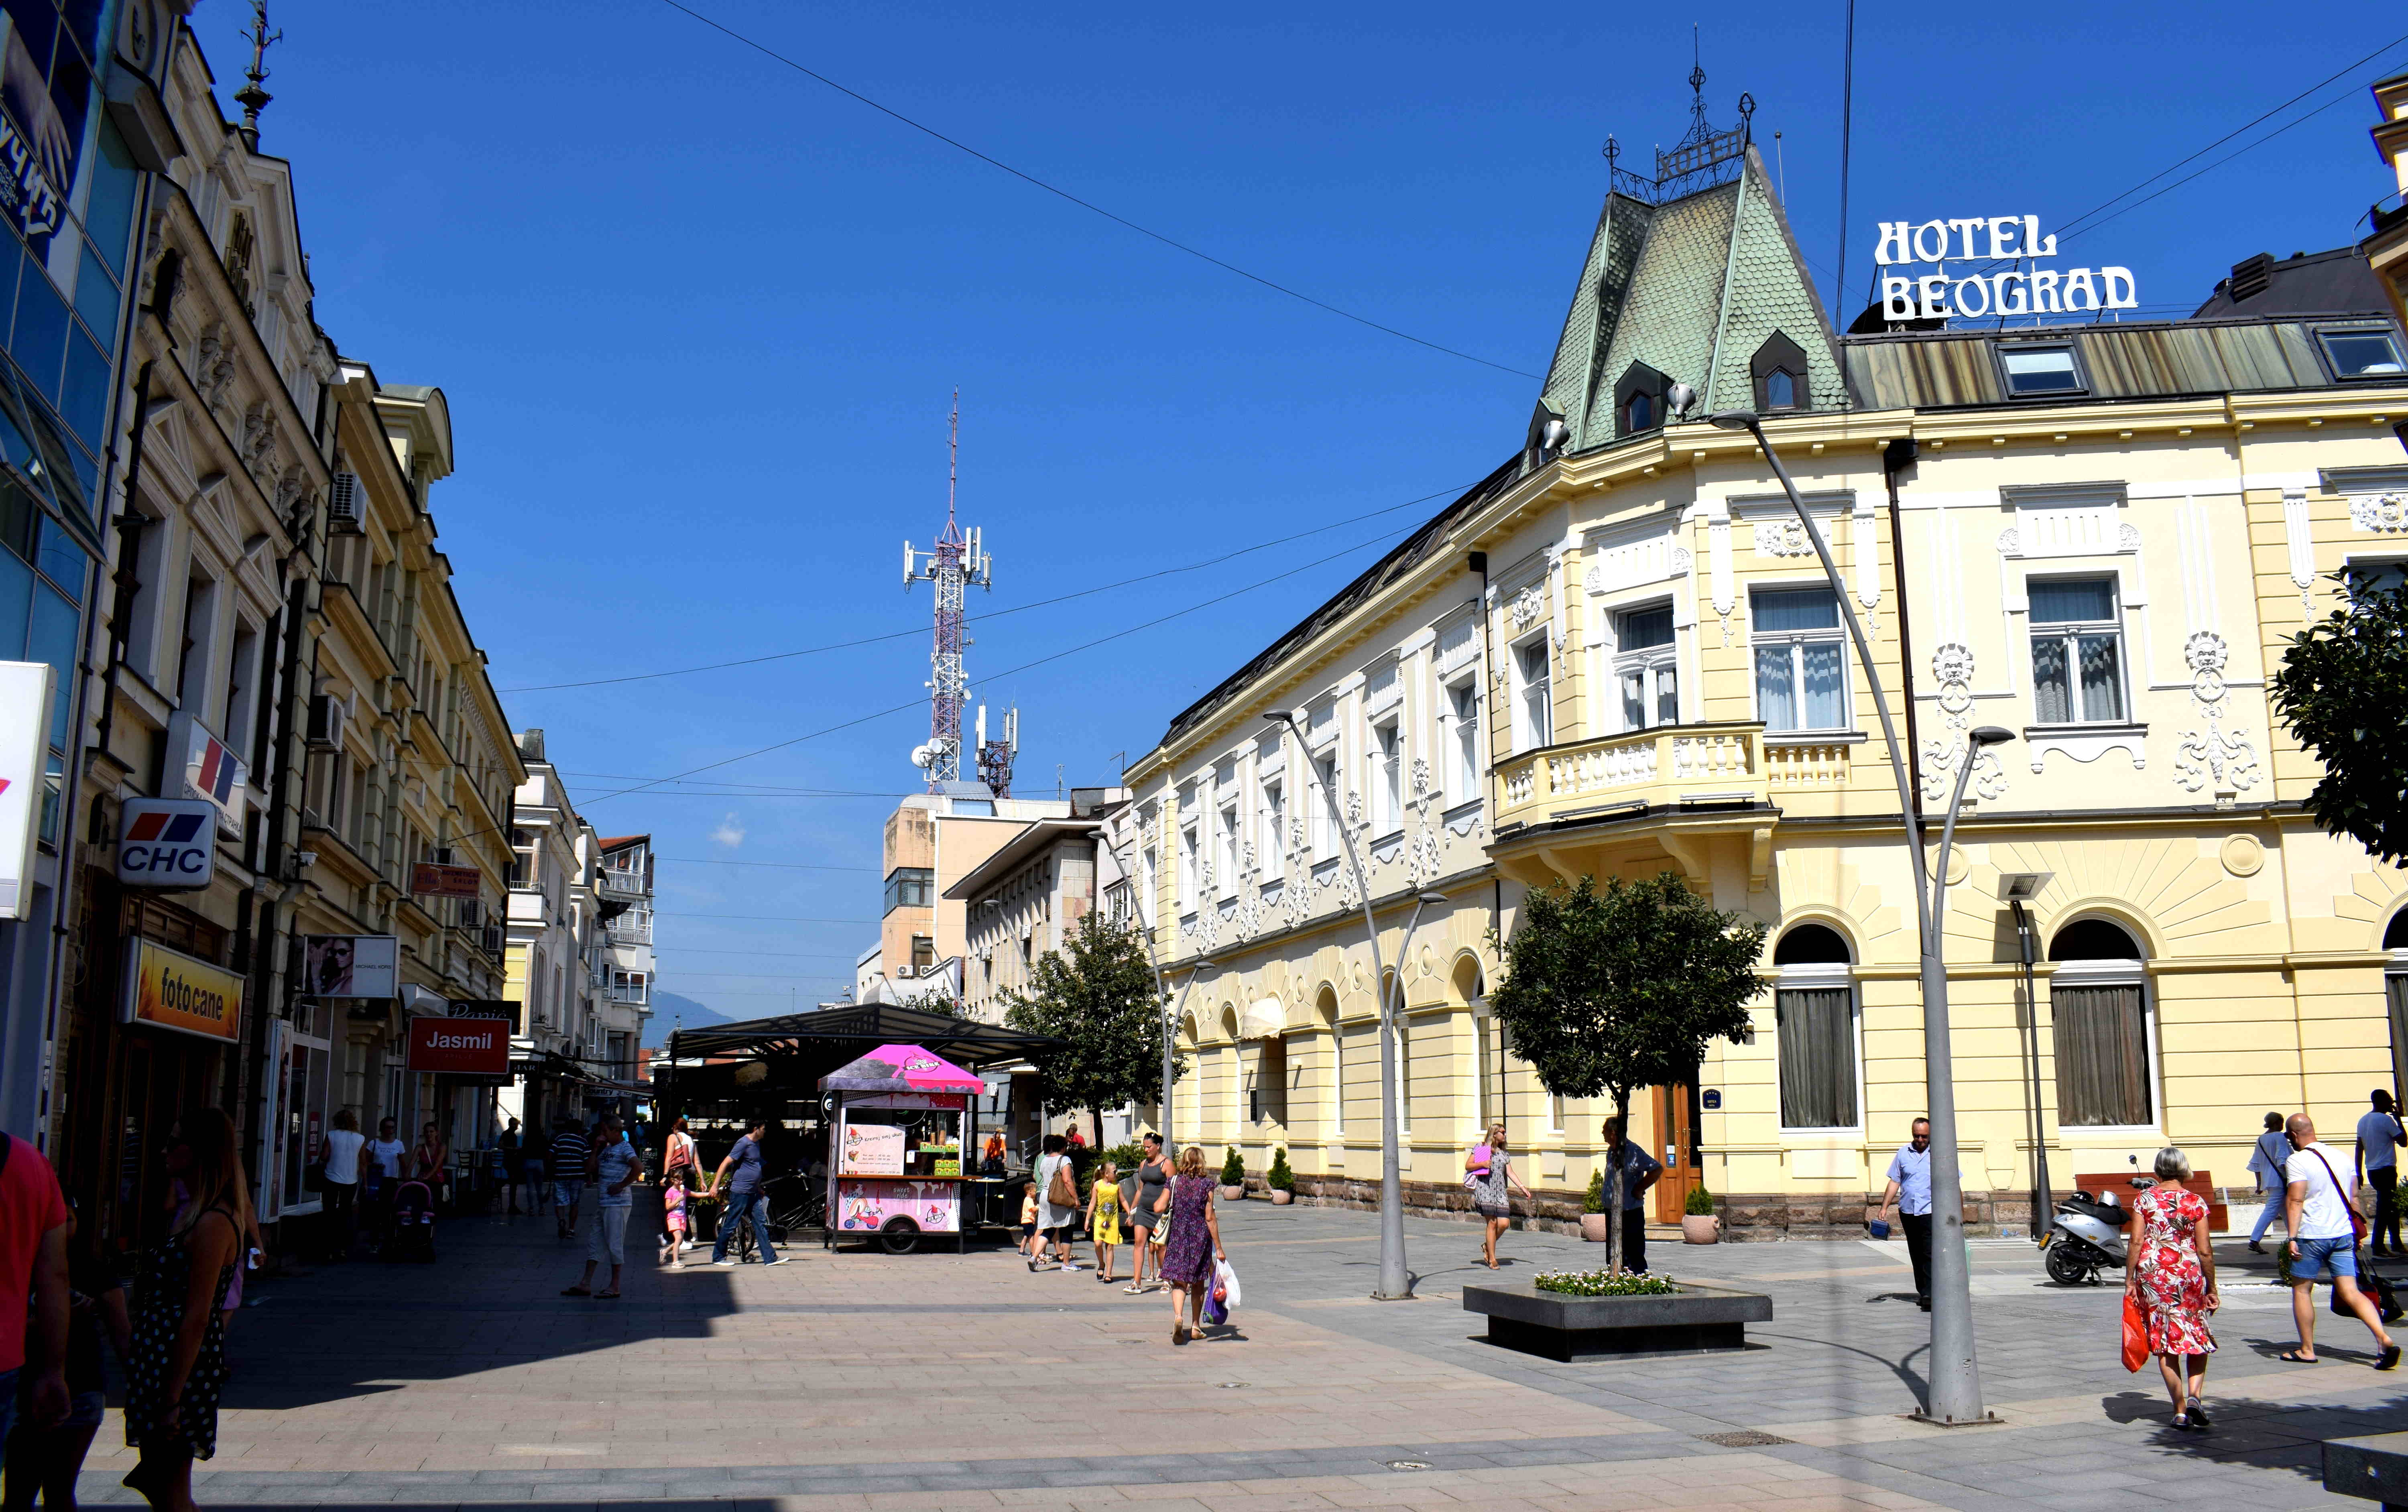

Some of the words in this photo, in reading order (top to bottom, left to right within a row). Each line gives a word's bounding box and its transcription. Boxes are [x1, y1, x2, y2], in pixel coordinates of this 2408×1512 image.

[1875, 215, 2057, 265] HOTEL
[1882, 266, 2138, 321] BEOGRAD
[426, 1031, 492, 1049] Jasmil
